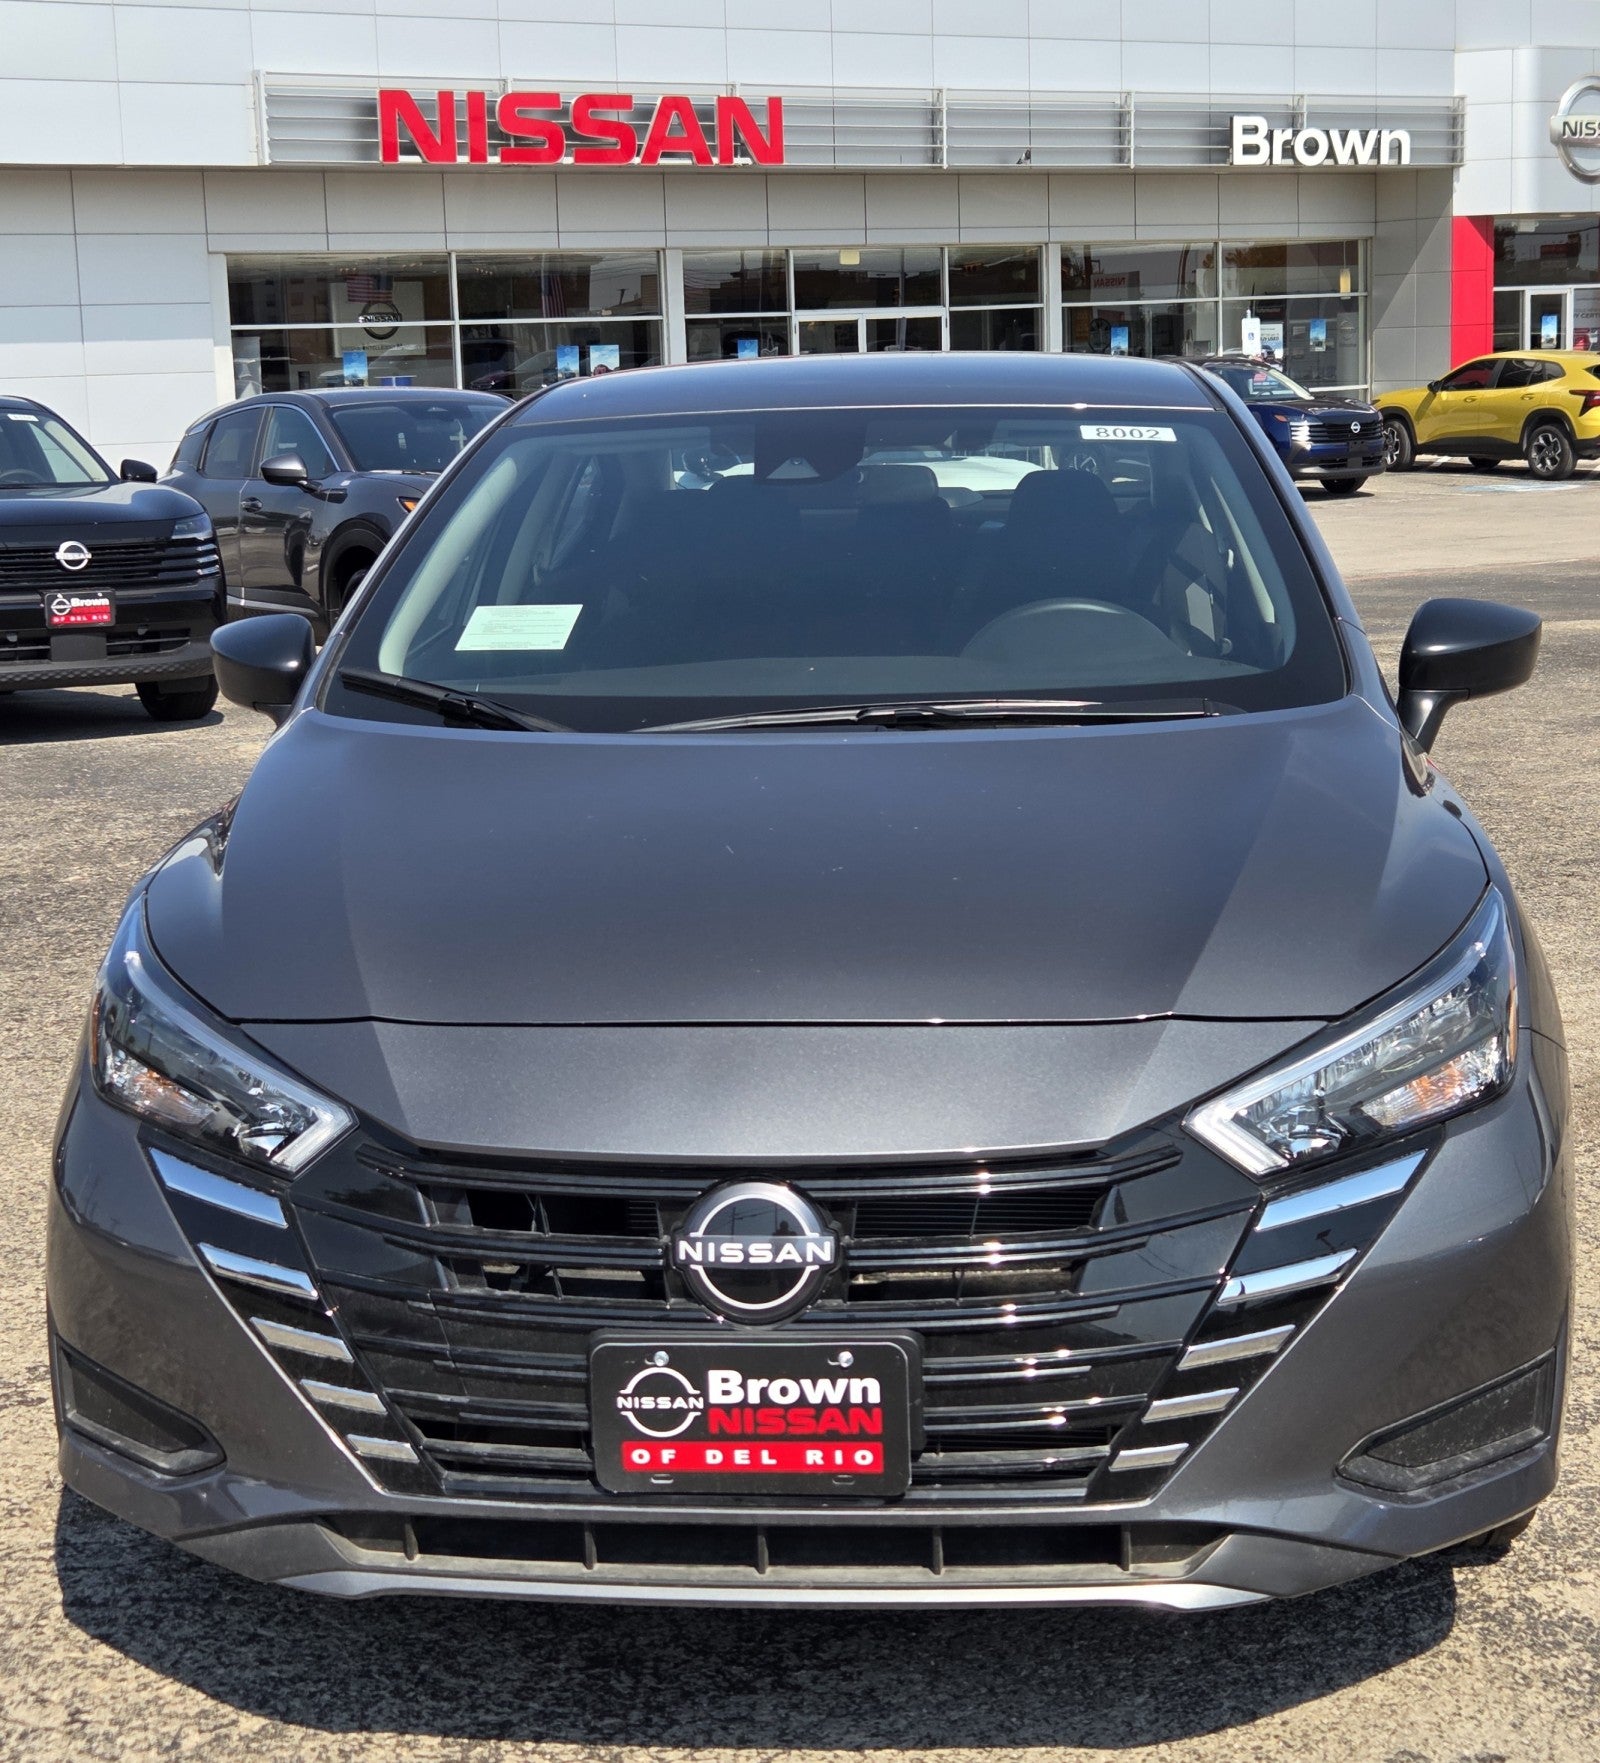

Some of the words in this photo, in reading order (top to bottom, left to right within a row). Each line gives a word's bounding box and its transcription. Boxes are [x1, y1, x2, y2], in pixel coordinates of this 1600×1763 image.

[378, 89, 785, 166] NISSAN
[1562, 121, 1600, 138] NIS
[1232, 115, 1411, 166] Brown
[1095, 427, 1160, 439] 8002
[70, 597, 110, 607] Brown
[678, 1239, 831, 1263] NISSAN
[707, 1369, 881, 1405] Brown
[616, 1396, 704, 1410] NISSAN
[707, 1407, 883, 1435] NISSAN
[631, 1448, 677, 1465] OF
[705, 1448, 777, 1465] DEL
[805, 1448, 874, 1466] RIO
